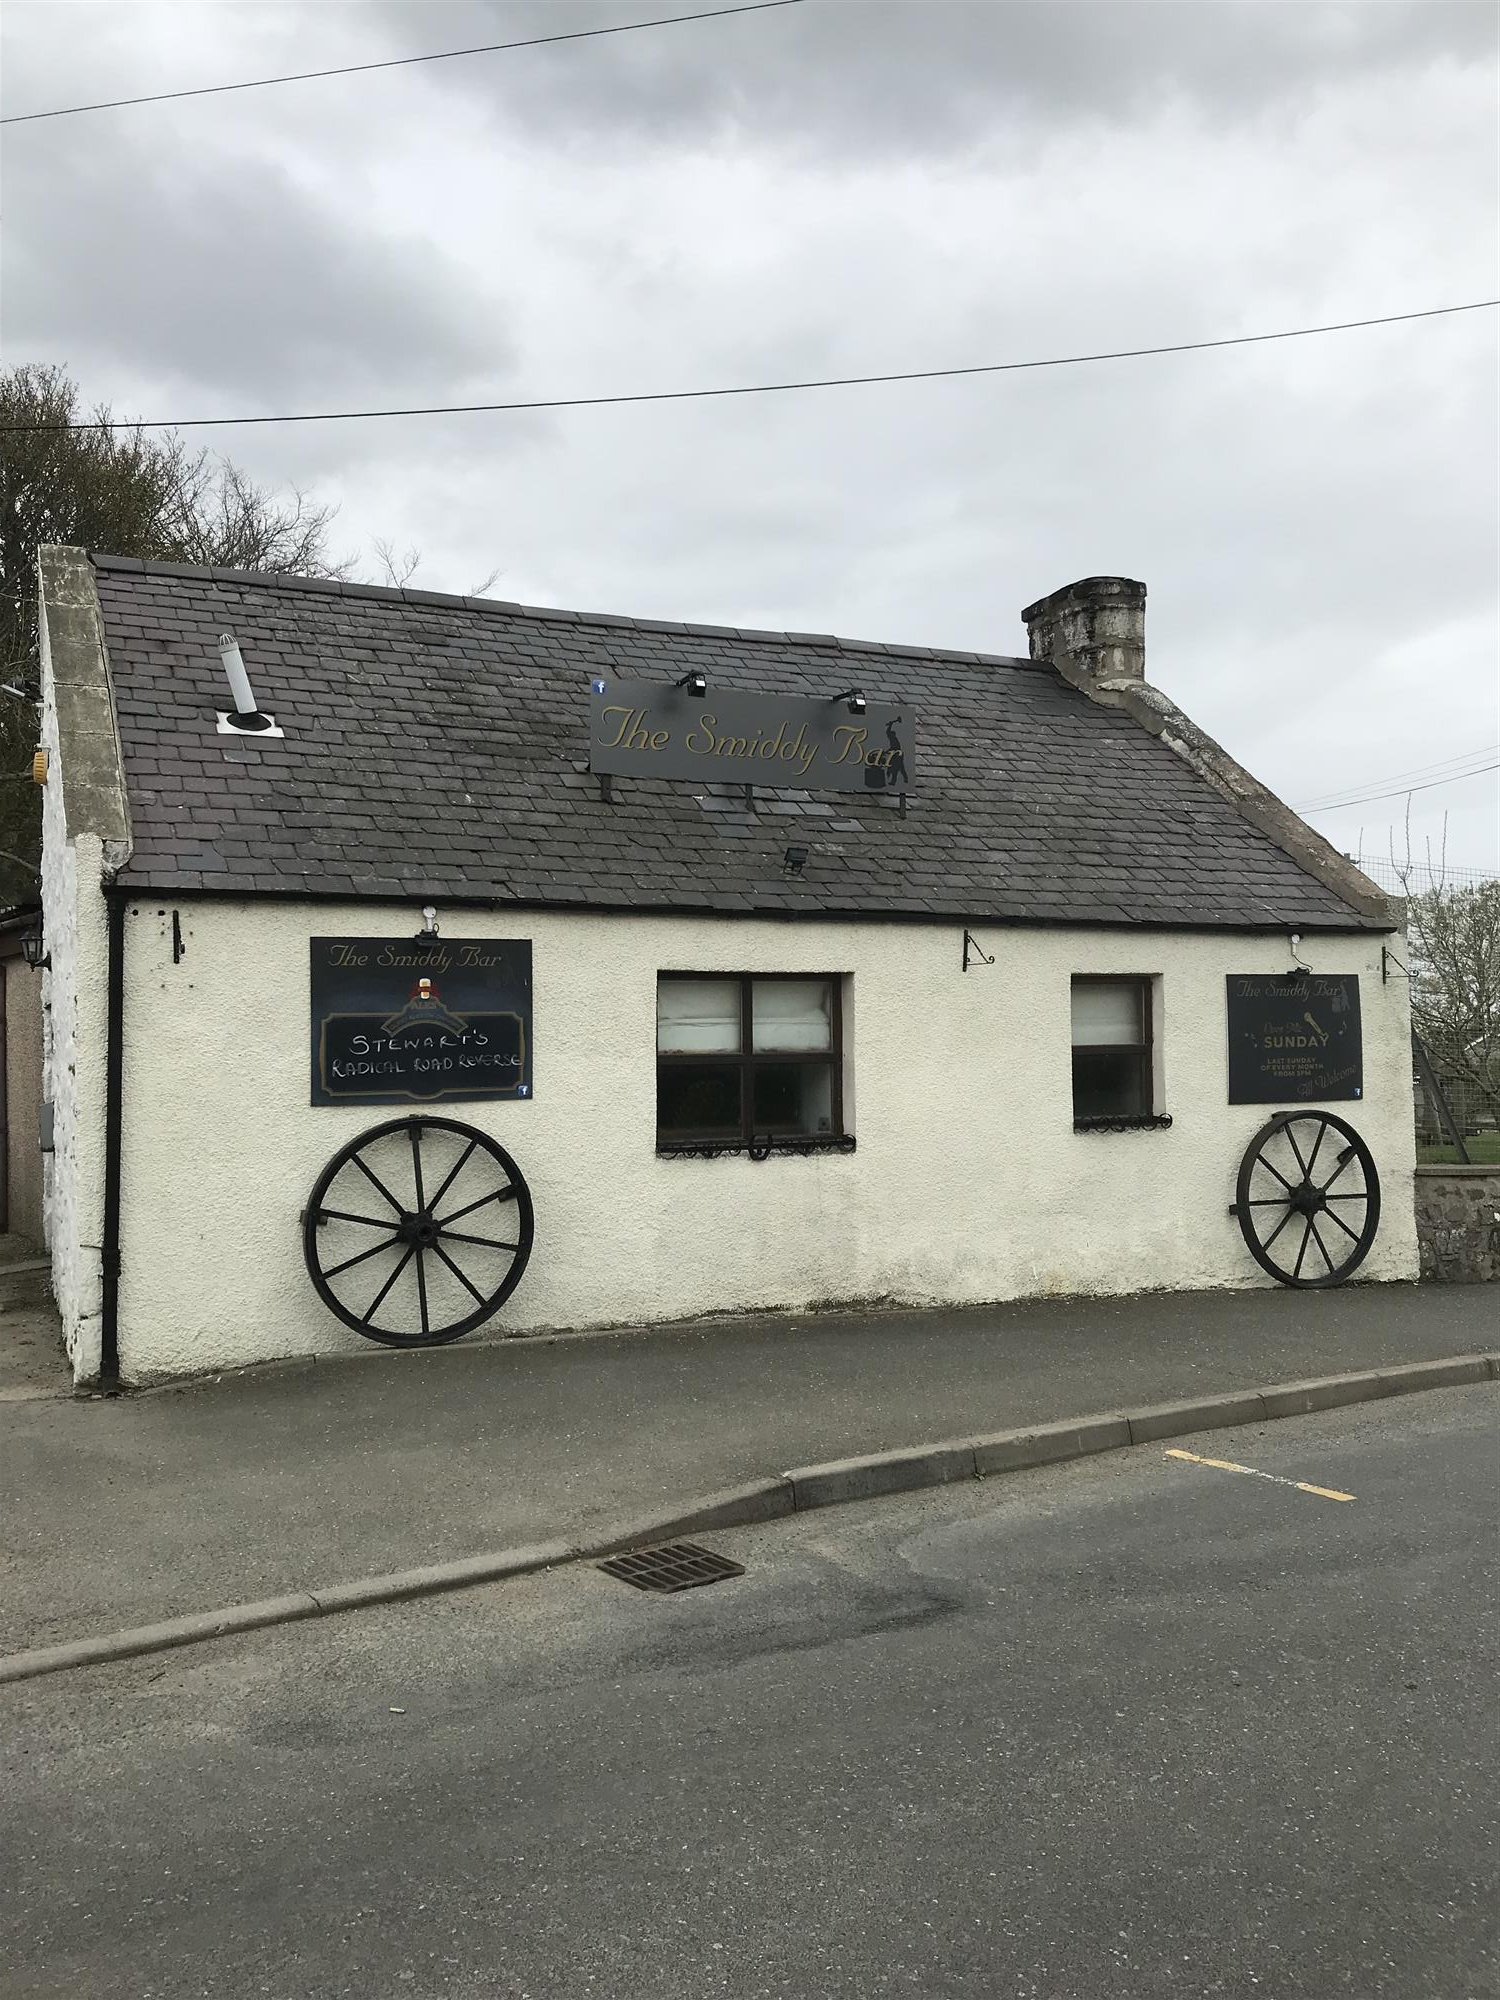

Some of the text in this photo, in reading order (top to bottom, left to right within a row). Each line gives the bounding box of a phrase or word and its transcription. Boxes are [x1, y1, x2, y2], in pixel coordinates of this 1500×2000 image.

[597, 706, 905, 776] The Smiddy Bar
[328, 944, 502, 974] The Smiddy Bar
[1236, 979, 1341, 1001] The Smiddy Bar
[349, 1029, 489, 1055] STEWART'S
[1264, 1035, 1329, 1049] SUNDAY
[332, 1053, 524, 1078] RADICAL ROAD REVERSE
[1260, 1064, 1270, 1072] OF
[1267, 1056, 1317, 1065] LAST SUNDAY
